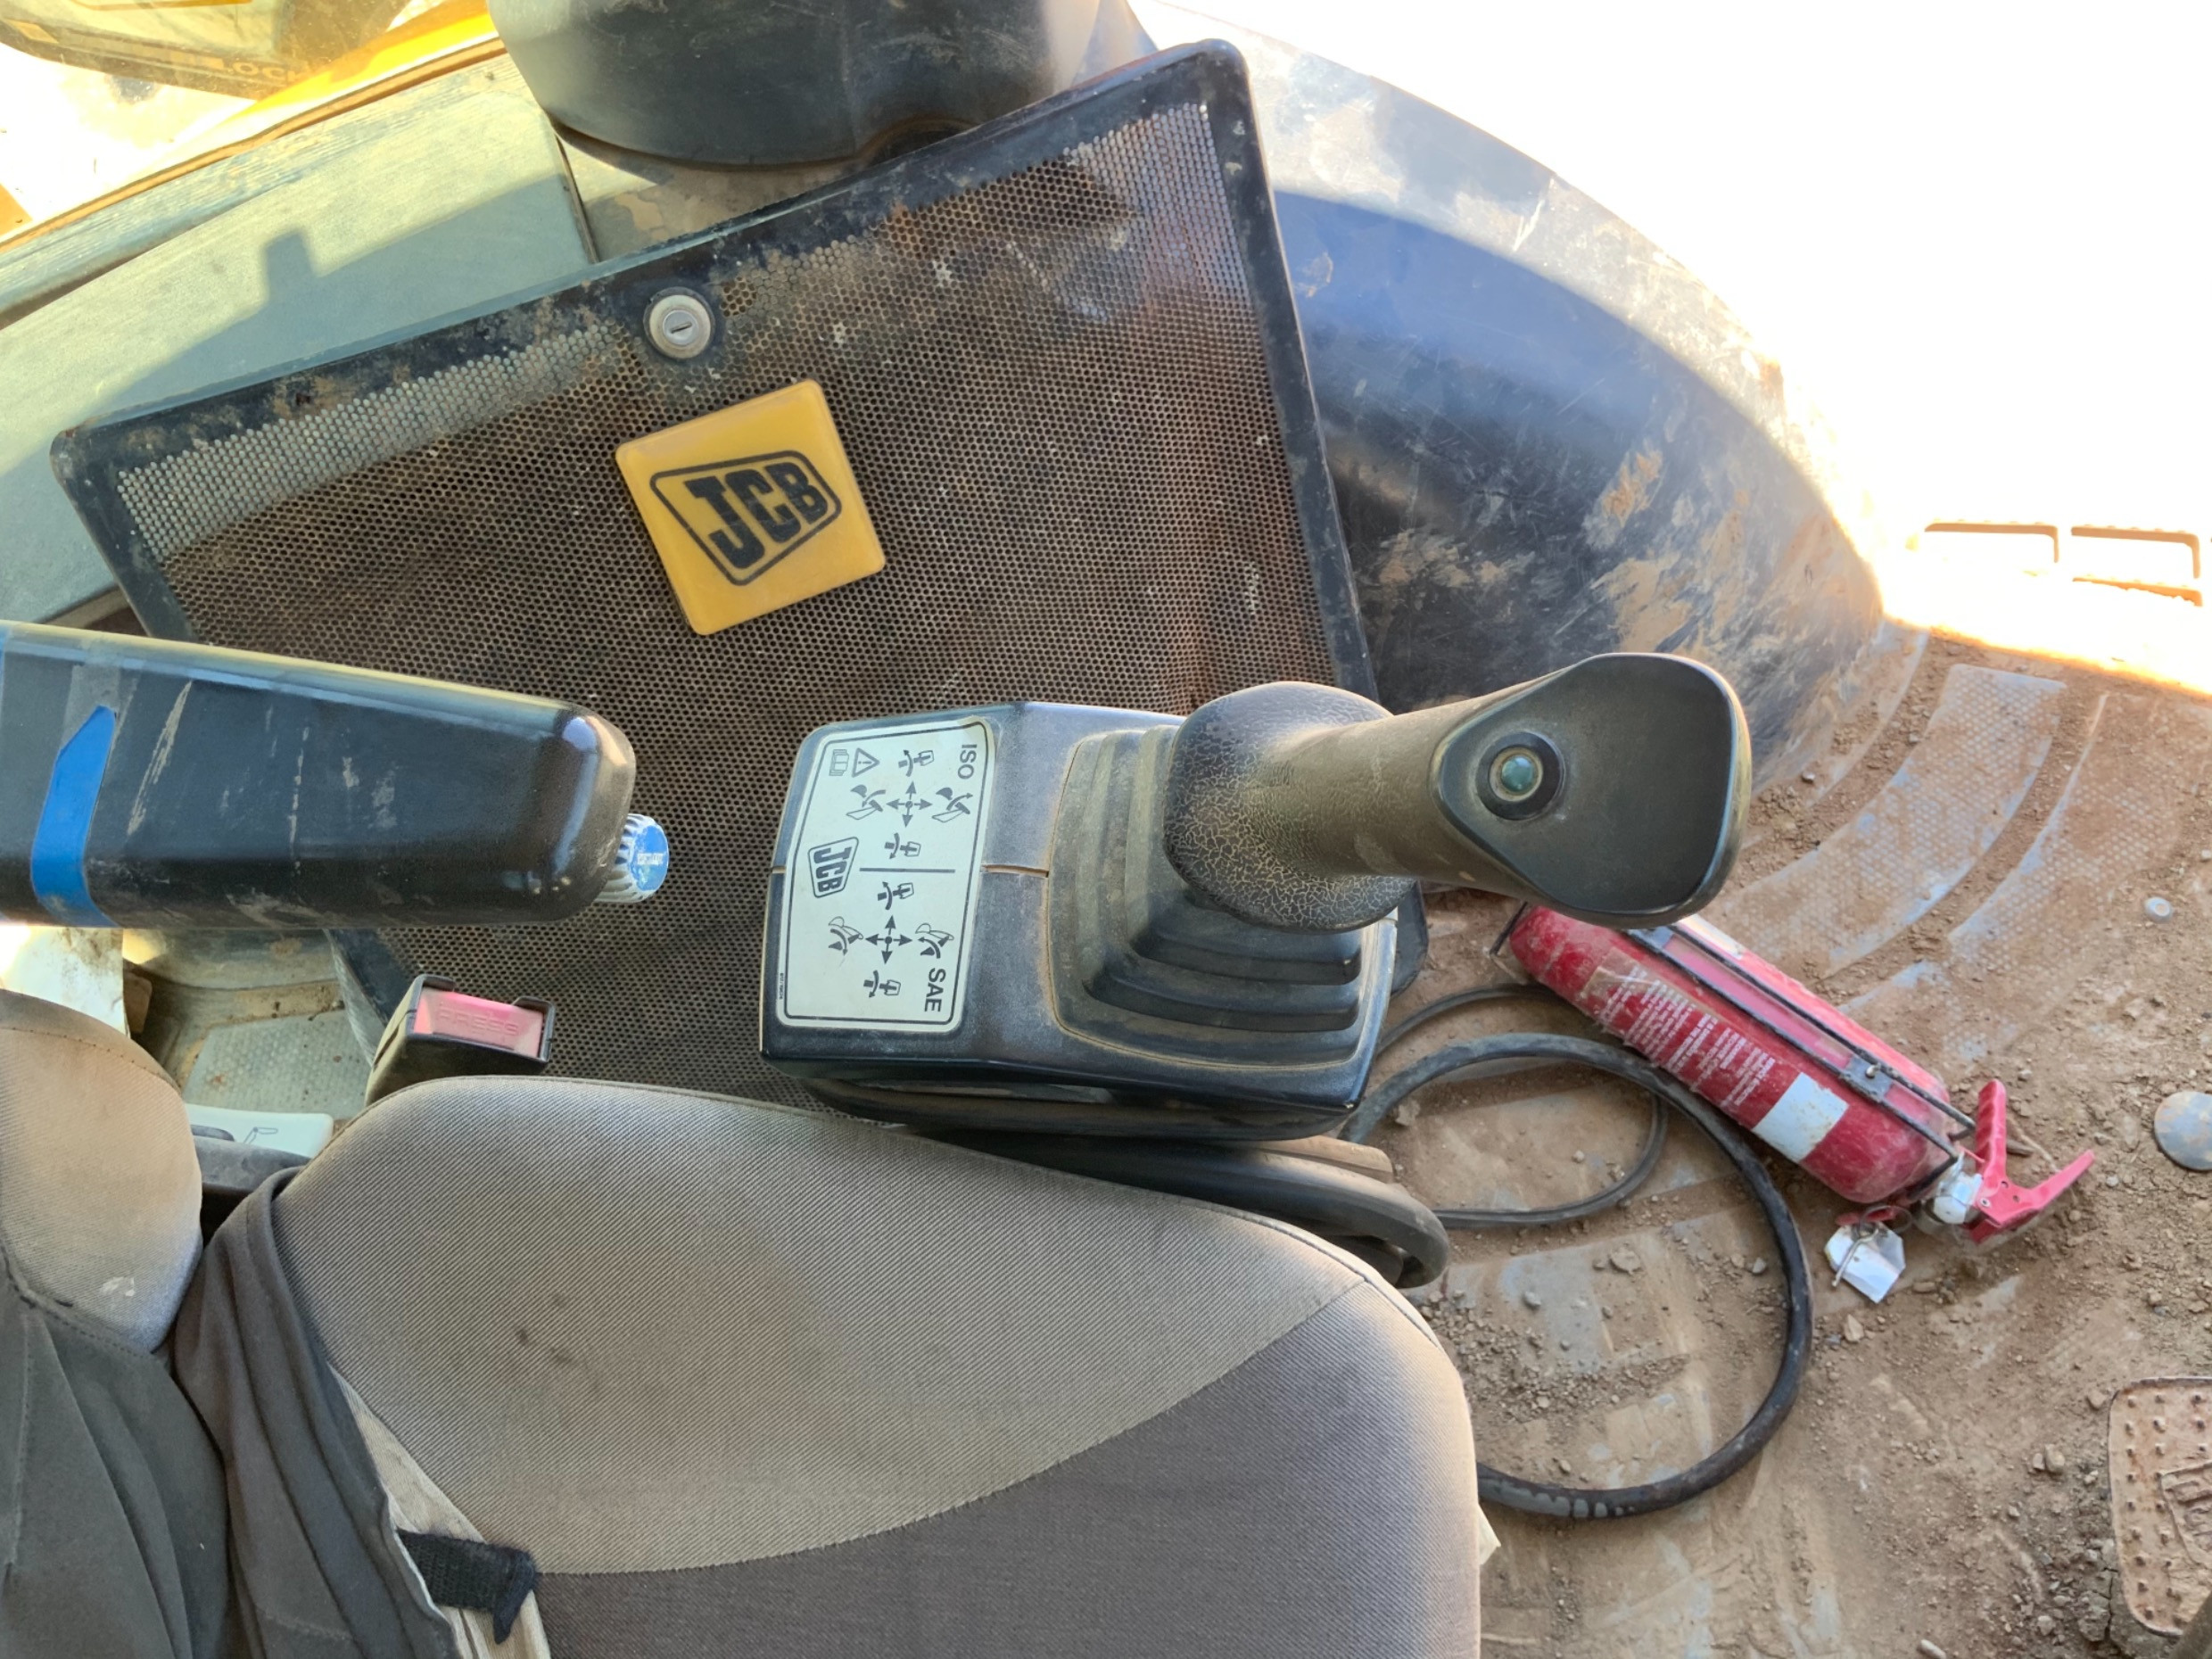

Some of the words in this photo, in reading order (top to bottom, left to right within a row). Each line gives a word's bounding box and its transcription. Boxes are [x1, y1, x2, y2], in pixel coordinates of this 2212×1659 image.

[684, 462, 829, 569] JCB
[957, 744, 977, 780] ISO
[813, 846, 850, 893] JCB
[924, 968, 946, 1012] SAE
[436, 1005, 520, 1036] PRESS
